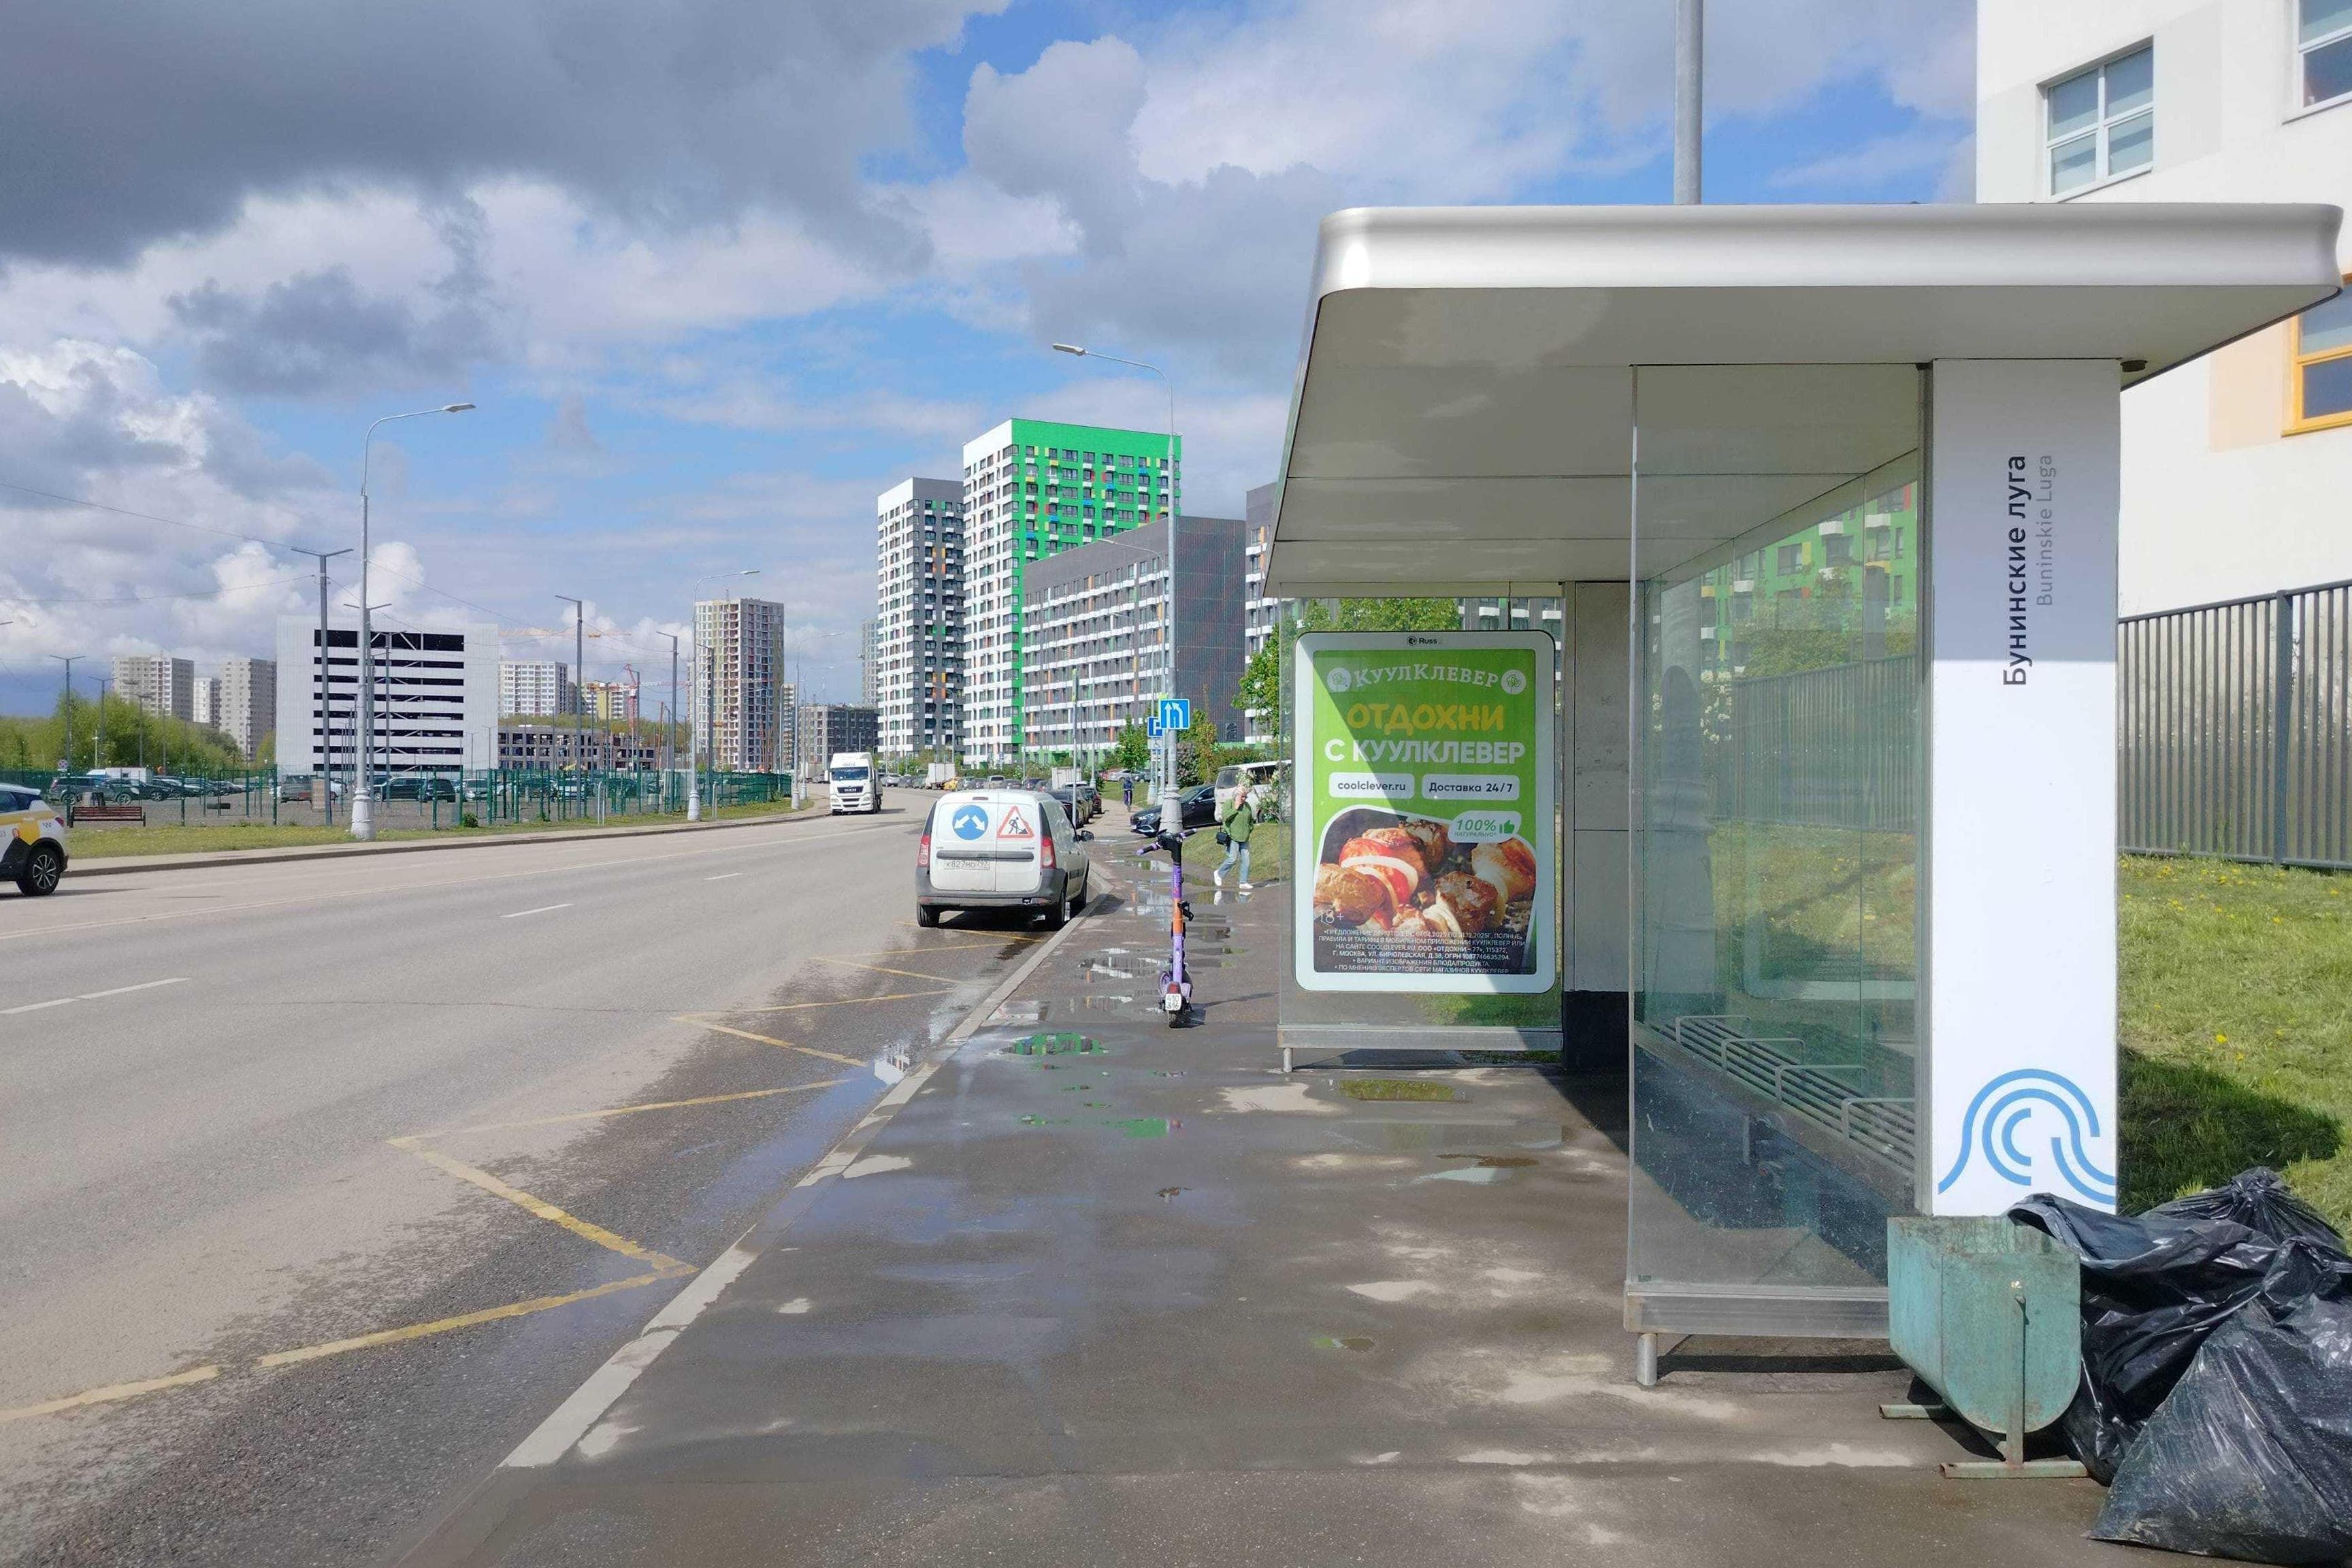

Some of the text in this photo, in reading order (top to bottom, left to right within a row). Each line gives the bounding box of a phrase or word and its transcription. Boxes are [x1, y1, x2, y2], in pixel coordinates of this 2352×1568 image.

[2036, 455, 2056, 606] Buninskie Luga
[2003, 455, 2032, 685] Бунинские луга
[1418, 637, 1438, 645] Russ
[1354, 664, 1499, 687] КУУЛКЛЕВЕР
[1347, 702, 1504, 736] ОТДОХНИ
[1324, 738, 1526, 764] С КУУЛКЛЕВЕР
[1337, 781, 1406, 791] coolclever.ru
[1428, 782, 1513, 793] Доставка 24/7
[1457, 819, 1497, 832] 100%
[1321, 909, 1345, 924] 18+
